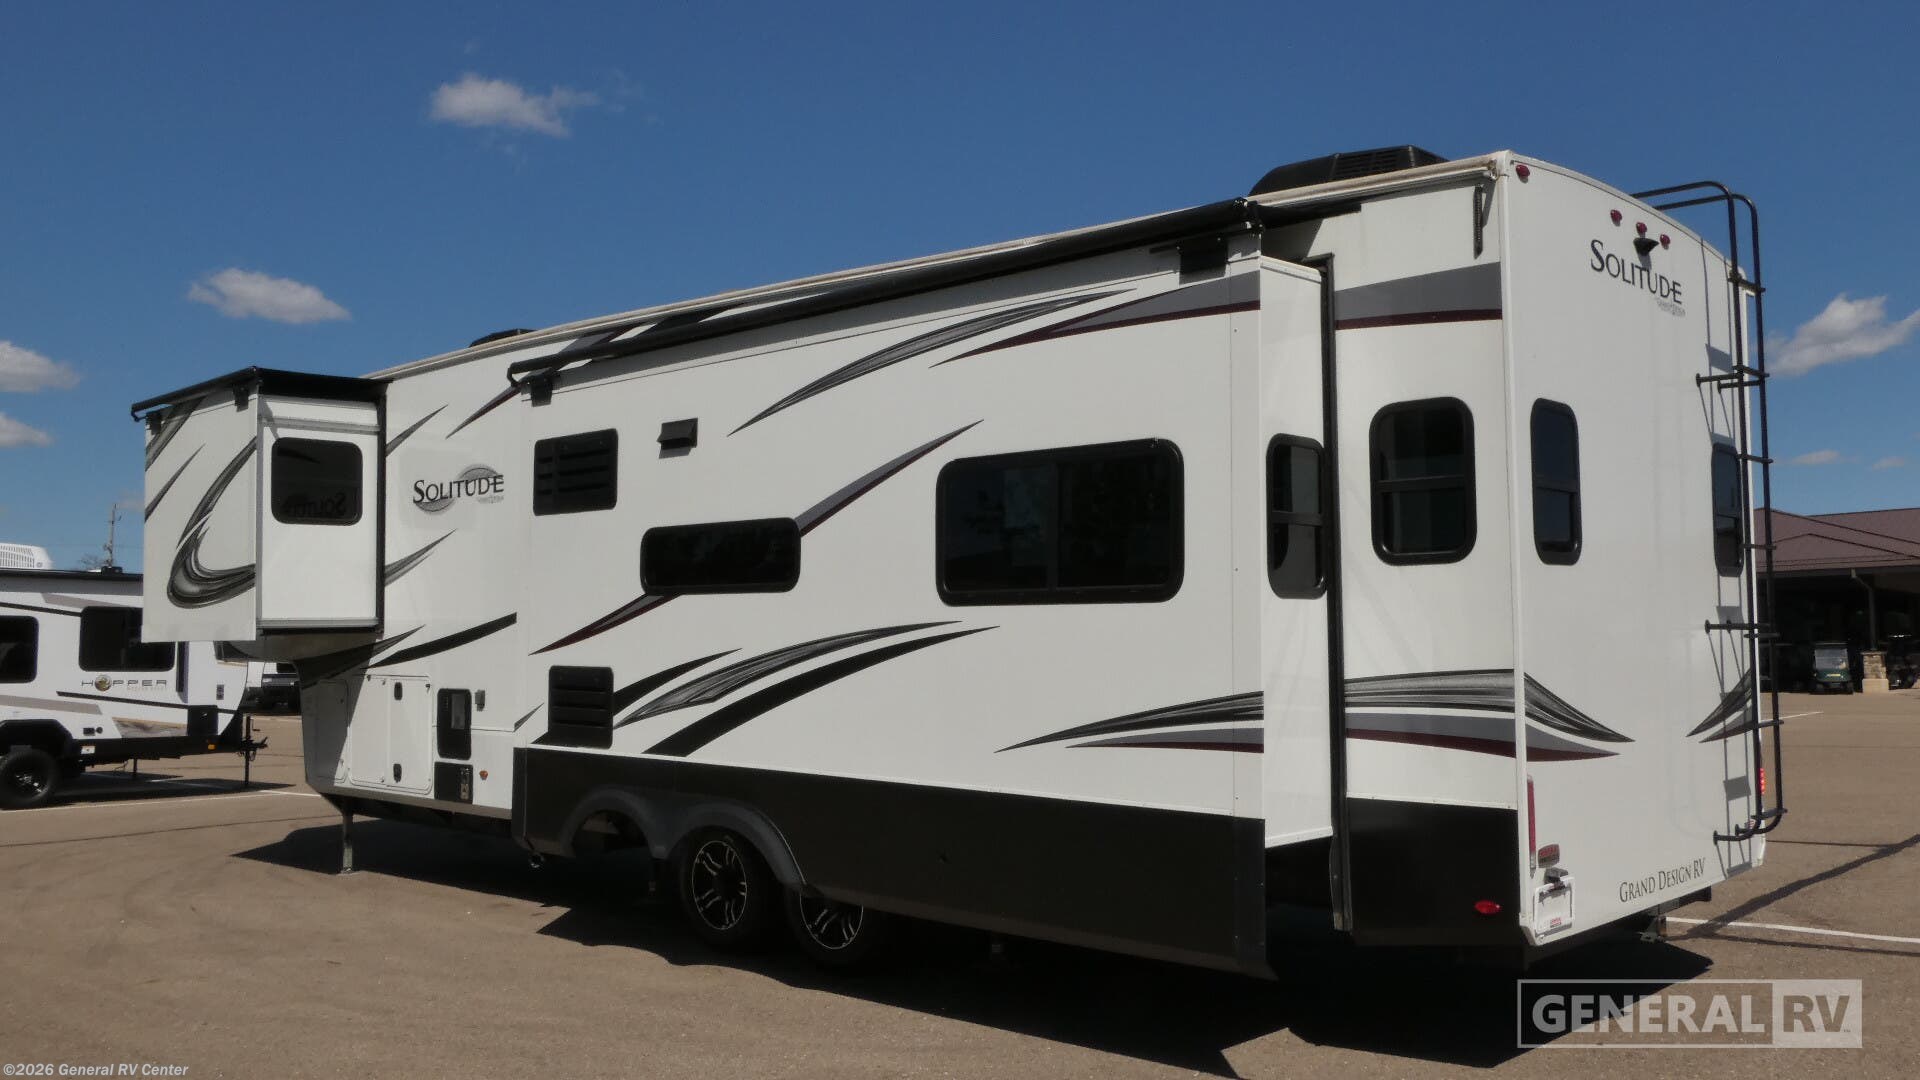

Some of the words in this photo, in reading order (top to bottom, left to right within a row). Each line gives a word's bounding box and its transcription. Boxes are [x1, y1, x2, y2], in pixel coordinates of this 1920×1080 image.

[1591, 239, 1682, 305] SOLITUDE
[413, 474, 505, 503] SOLITUDE
[1619, 876, 1656, 903] GRAND
[1658, 865, 1692, 890] DESIGN
[1693, 857, 1706, 879] RV
